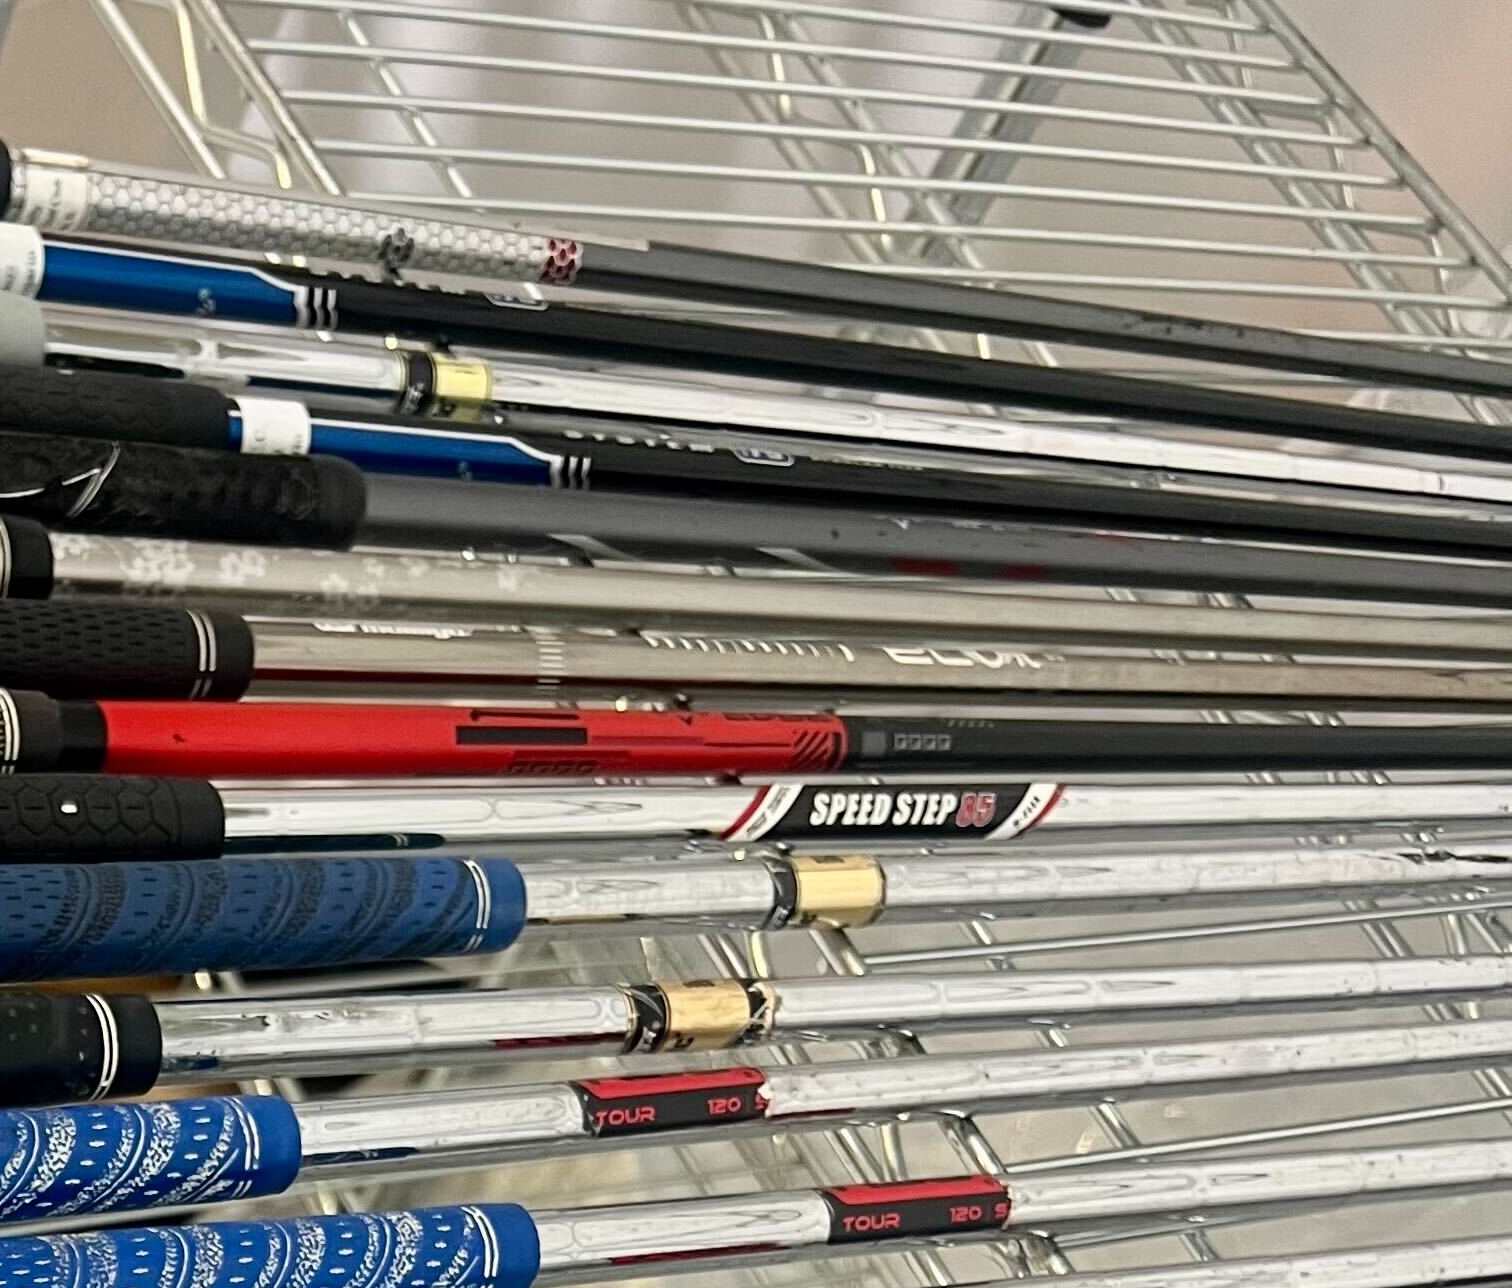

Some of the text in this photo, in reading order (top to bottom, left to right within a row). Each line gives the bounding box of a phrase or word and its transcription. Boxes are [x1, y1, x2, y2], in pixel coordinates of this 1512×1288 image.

[809, 792, 891, 826] SPEED
[892, 792, 957, 826] STEP
[595, 1106, 656, 1128] TOUR
[707, 1097, 741, 1115] 120
[842, 1213, 900, 1233] TOUR
[949, 1206, 982, 1223] 120
